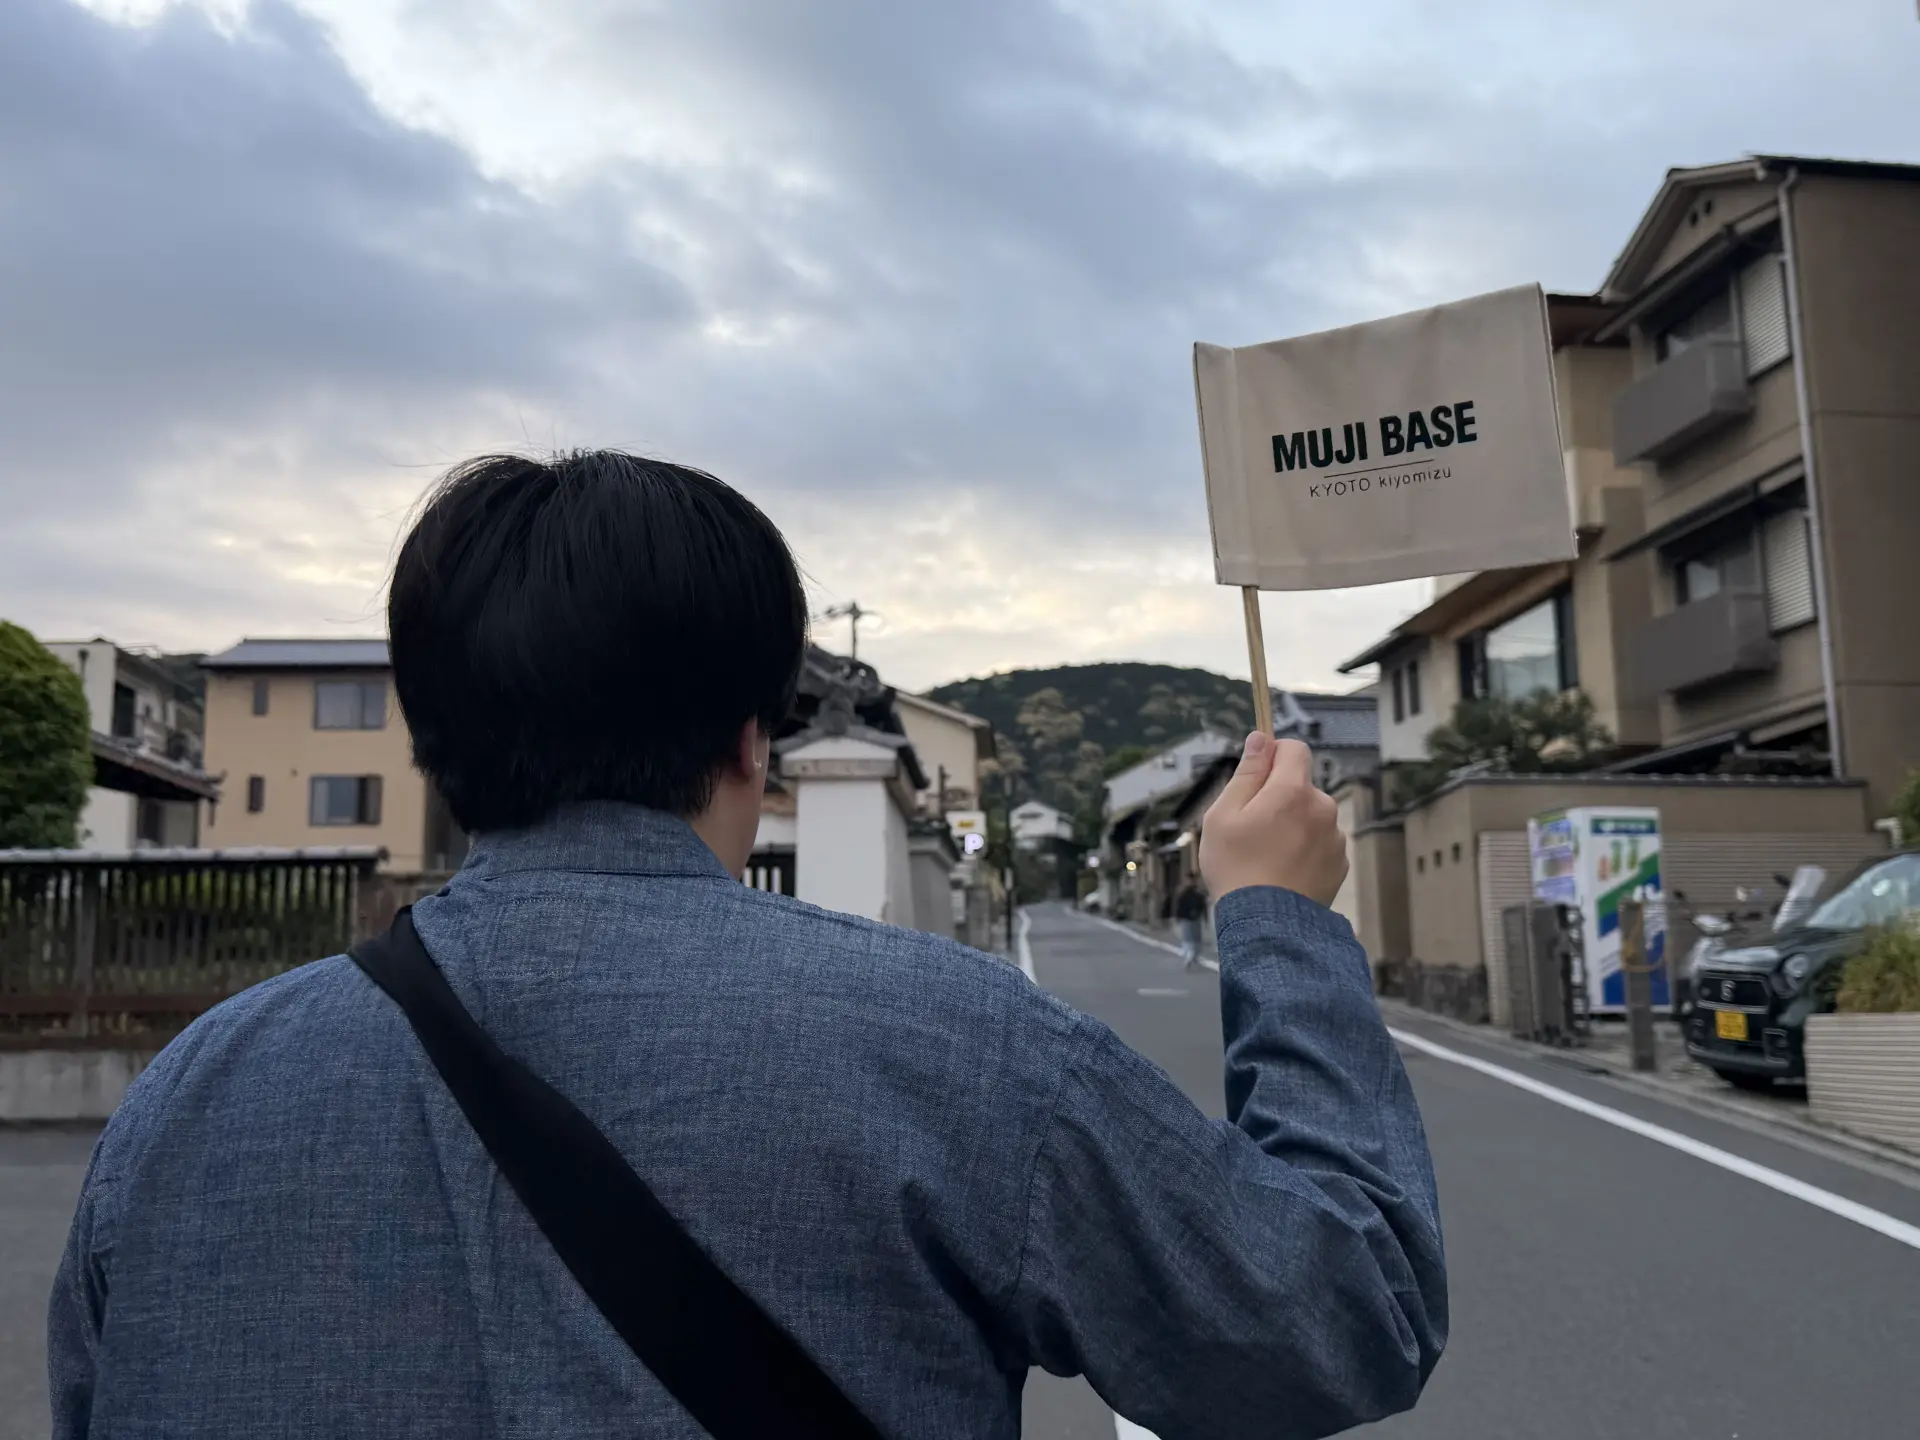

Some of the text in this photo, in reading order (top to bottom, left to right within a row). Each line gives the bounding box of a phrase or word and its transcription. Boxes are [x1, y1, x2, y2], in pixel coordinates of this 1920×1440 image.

[1271, 400, 1478, 473] MUJI BASE
[1309, 466, 1452, 498] KYOTO kiyomizu
